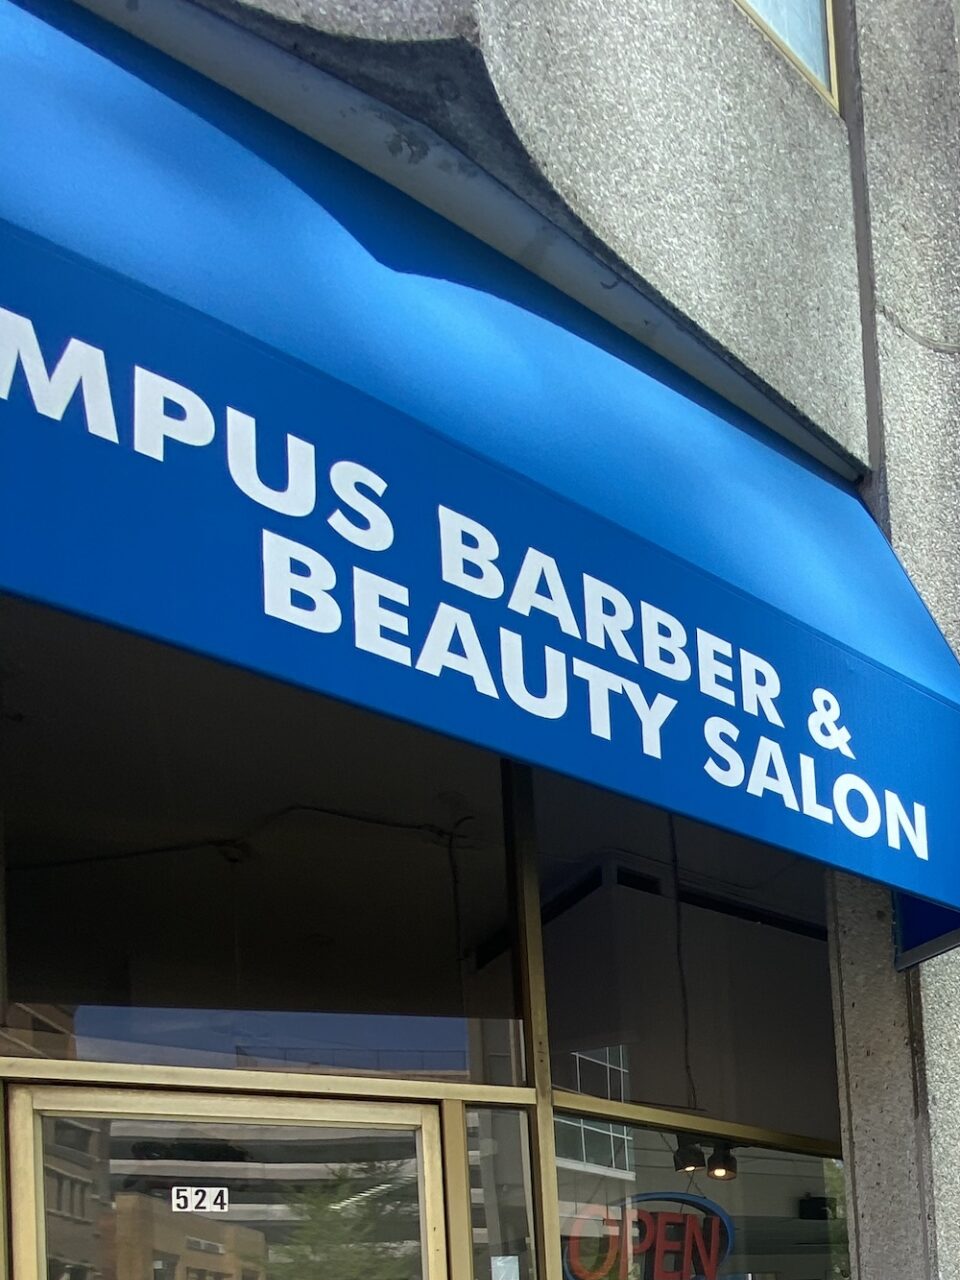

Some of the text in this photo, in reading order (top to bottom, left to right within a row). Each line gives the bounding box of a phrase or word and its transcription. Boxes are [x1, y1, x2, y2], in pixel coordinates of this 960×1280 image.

[0, 306, 856, 759] MPUS BARBER &
[261, 528, 929, 862] BEAUTY SALON
[175, 1188, 227, 1210] 524
